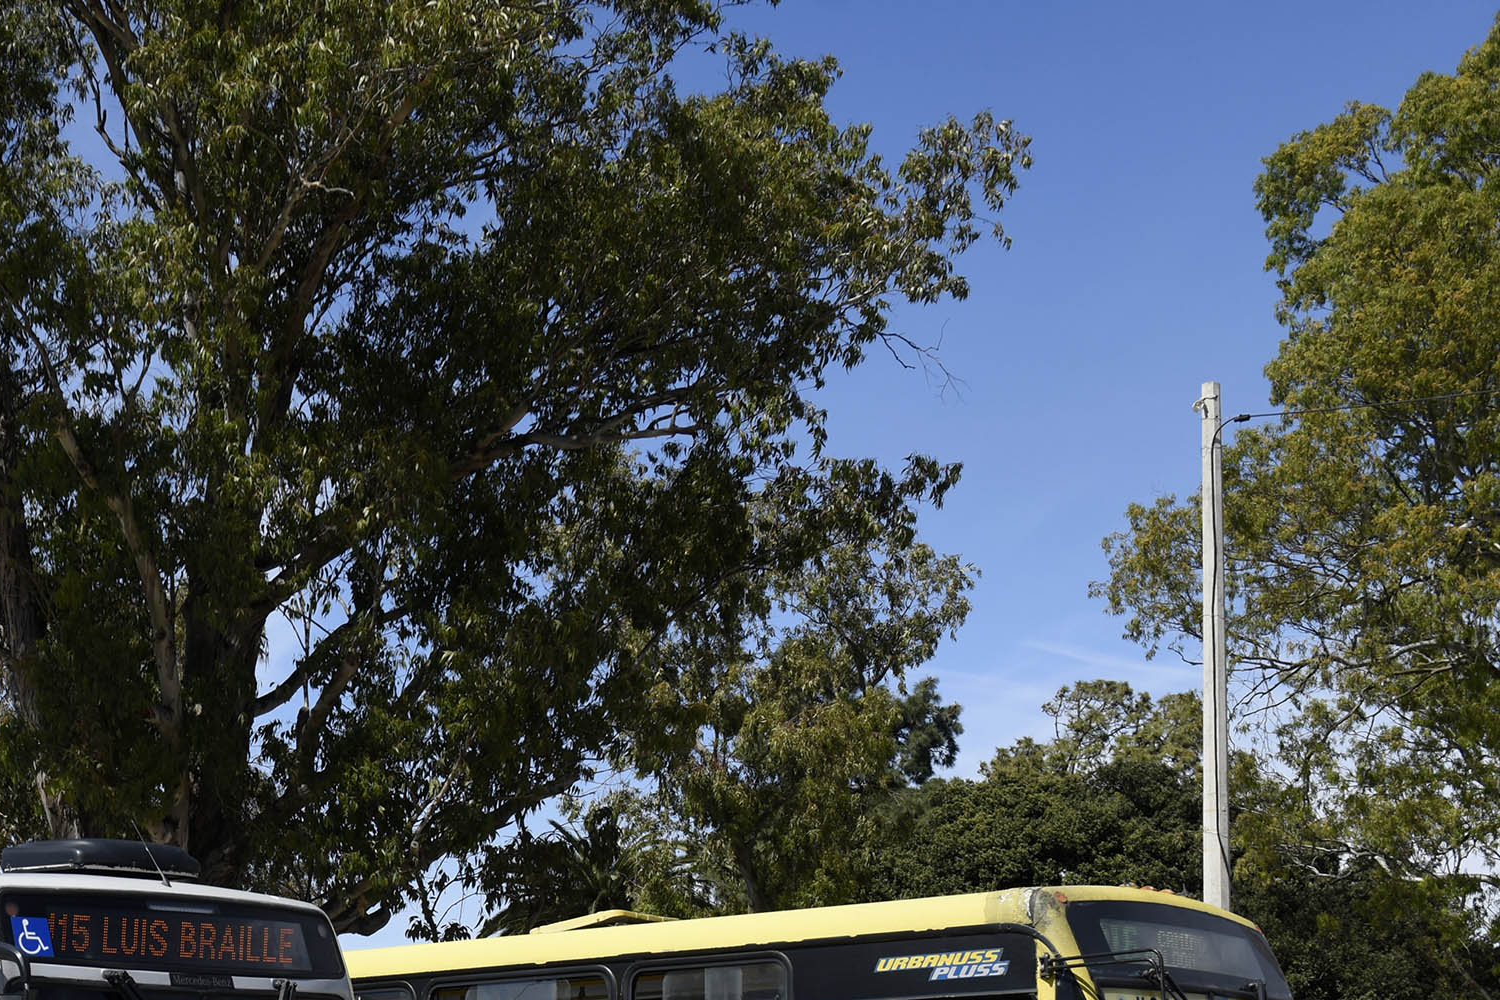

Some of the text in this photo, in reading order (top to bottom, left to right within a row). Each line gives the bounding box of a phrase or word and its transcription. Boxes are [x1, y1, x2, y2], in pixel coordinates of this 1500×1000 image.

[50, 913, 293, 963] 15 LUIS BRAILLE
[876, 949, 1002, 972] URBANUSS
[931, 962, 1008, 980] PLUSS
